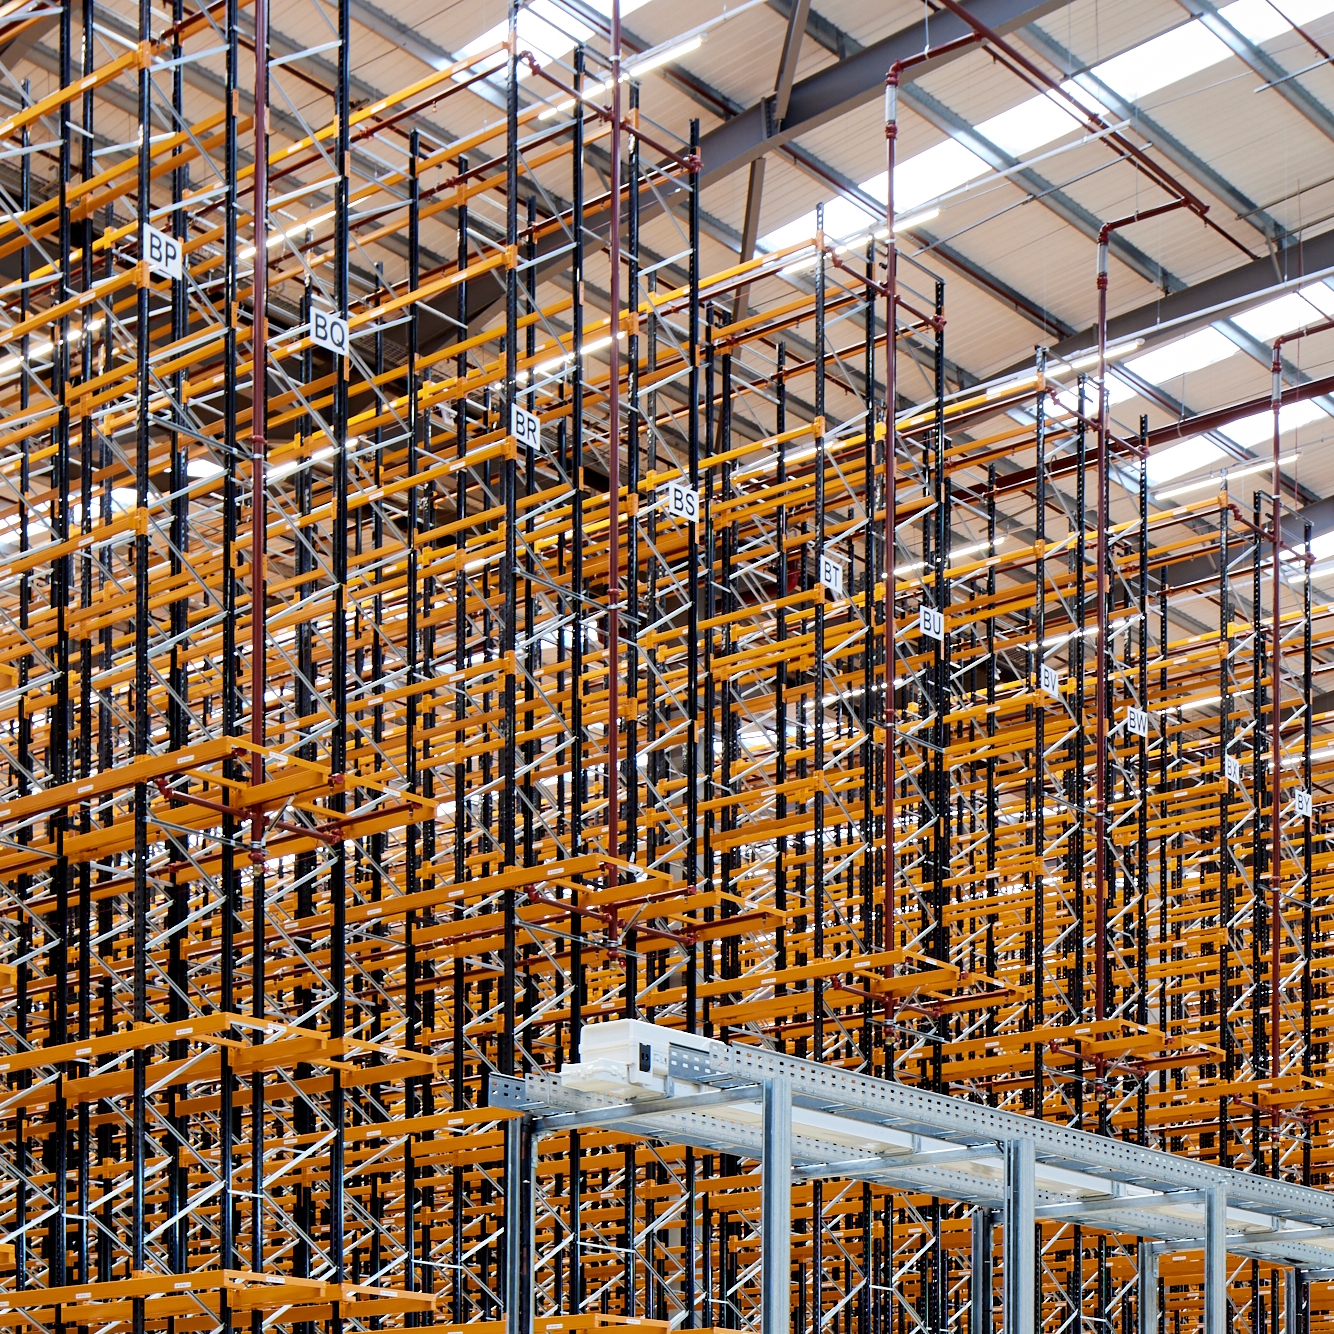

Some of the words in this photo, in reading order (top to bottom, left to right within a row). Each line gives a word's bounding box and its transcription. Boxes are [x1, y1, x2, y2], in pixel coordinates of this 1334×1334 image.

[149, 232, 177, 268] BP
[315, 313, 346, 351] BQ
[515, 410, 537, 445] BR
[674, 487, 695, 516] BS
[824, 564, 840, 594] BT
[923, 613, 941, 636] BU
[1043, 671, 1057, 692] BV
[1129, 712, 1147, 734] BW
[1227, 758, 1238, 778] BX
[1297, 793, 1309, 812] BY
